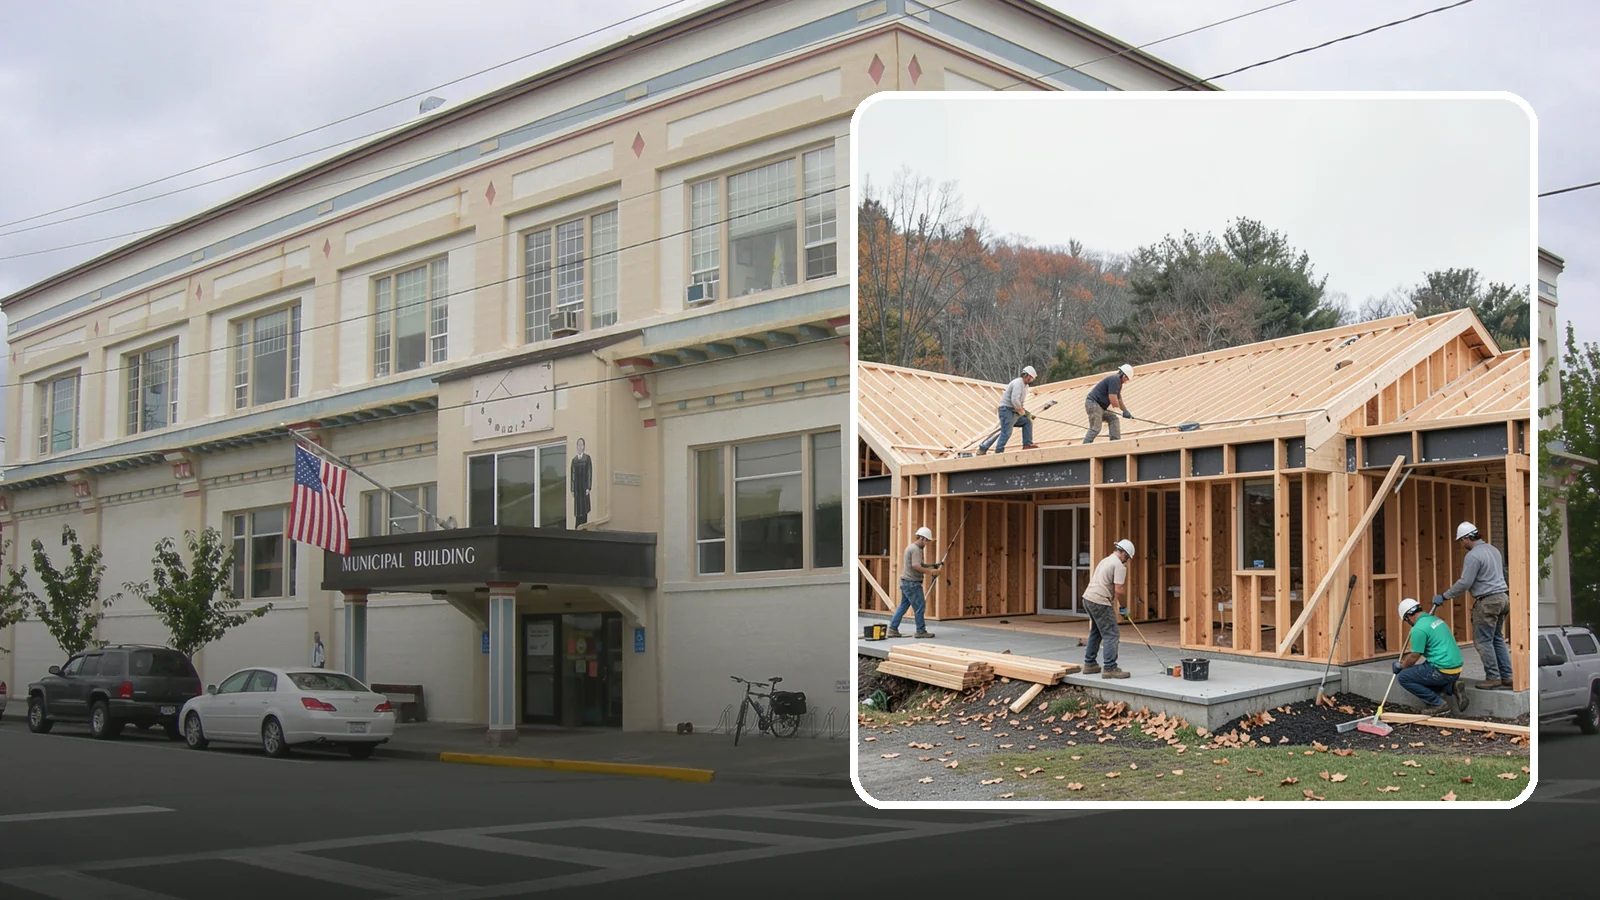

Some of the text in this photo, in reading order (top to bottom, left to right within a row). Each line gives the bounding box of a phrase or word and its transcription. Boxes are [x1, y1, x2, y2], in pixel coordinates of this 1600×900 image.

[481, 407, 485, 415] 8
[488, 417, 492, 426] 9
[502, 425, 506, 433] 11
[508, 425, 513, 433] 12
[521, 420, 525, 428] 2
[529, 414, 533, 422] 3
[536, 402, 540, 410] 4
[342, 546, 475, 572] MUNICIPAL BUILDING
